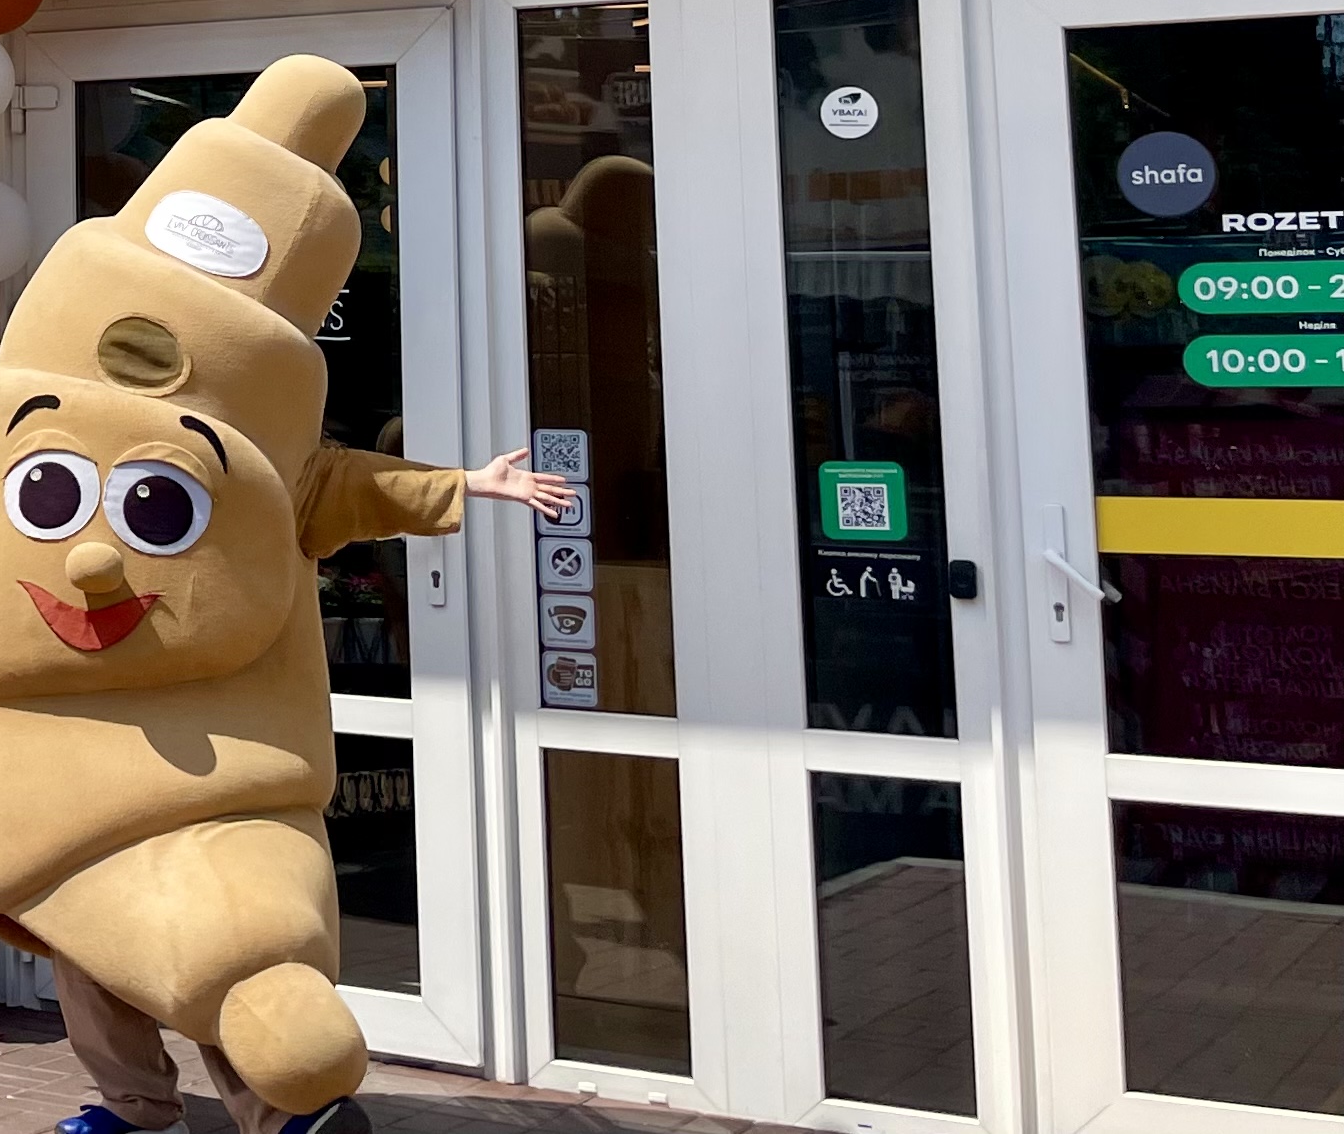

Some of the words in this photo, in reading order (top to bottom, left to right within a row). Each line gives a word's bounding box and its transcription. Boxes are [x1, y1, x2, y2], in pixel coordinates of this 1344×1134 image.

[1131, 164, 1203, 185] shafa
[1221, 211, 1344, 232] ROZET
[1193, 275, 1299, 301] 09:00
[1205, 349, 1306, 373] 10:00
[575, 677, 593, 686] GO
[578, 669, 593, 678] TO
